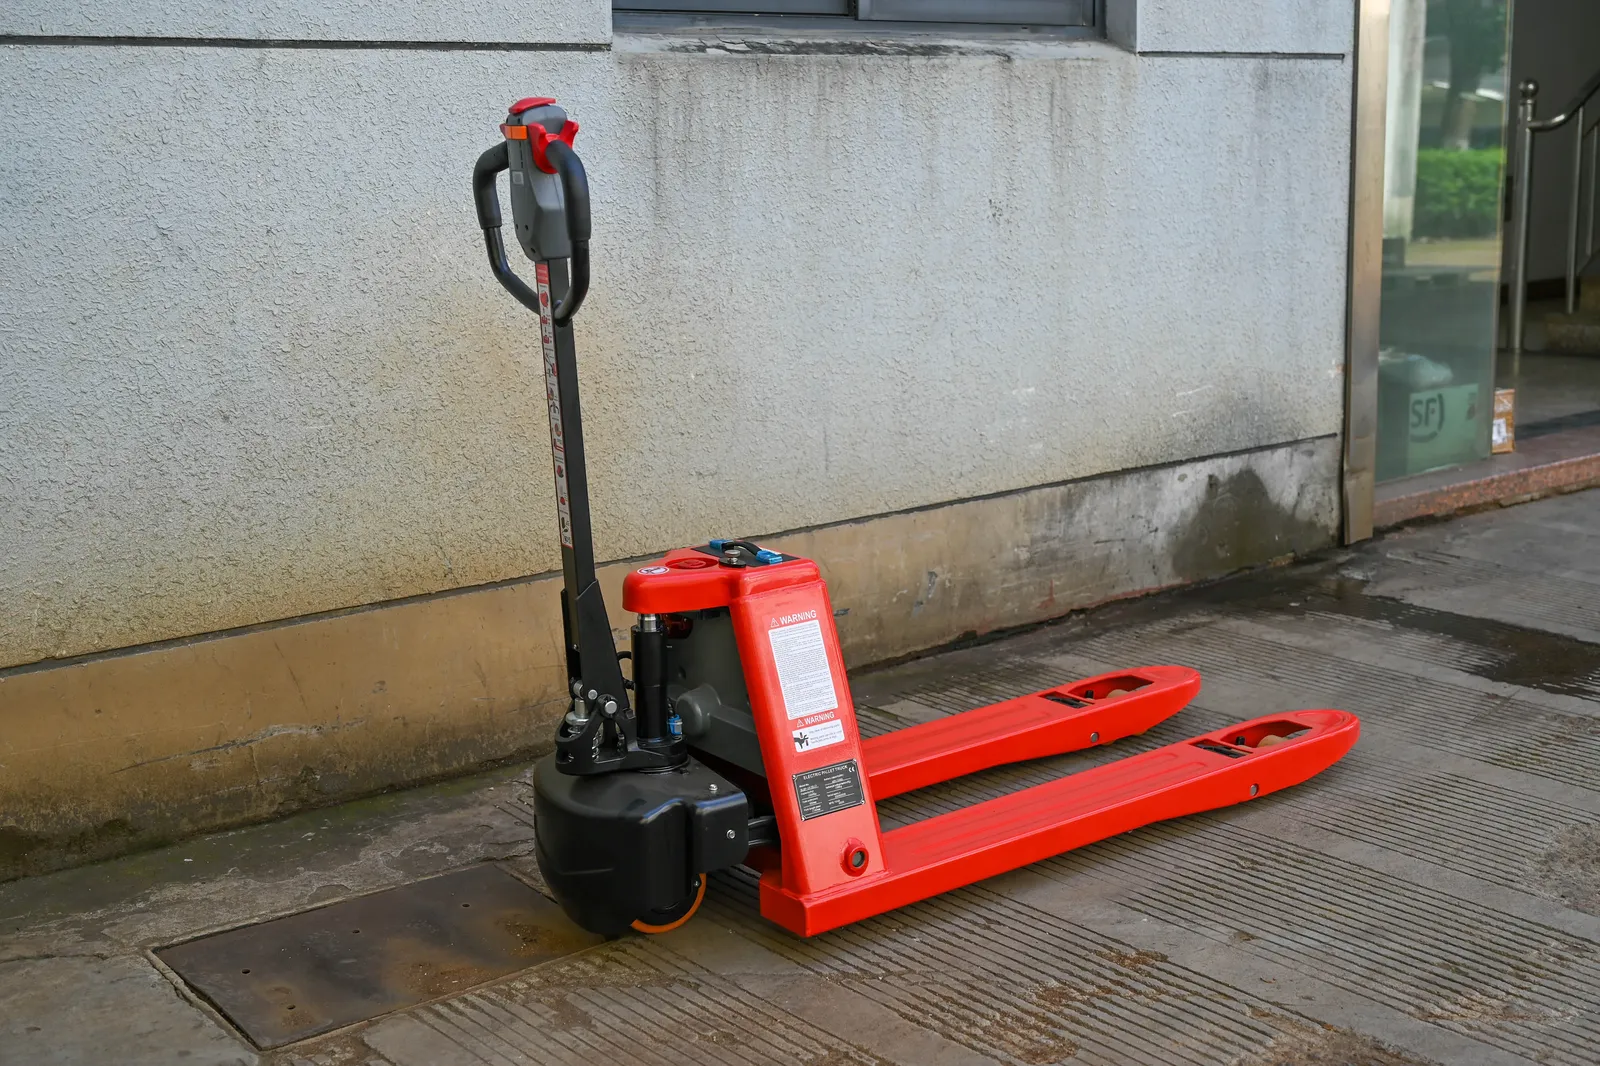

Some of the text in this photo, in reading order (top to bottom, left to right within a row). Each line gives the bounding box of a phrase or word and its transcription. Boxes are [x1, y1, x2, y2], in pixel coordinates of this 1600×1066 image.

[1410, 397, 1437, 429] SF
[780, 610, 817, 625] WARNING
[805, 711, 835, 724] WARNING
[803, 771, 821, 780] ELECTRIC
[821, 767, 835, 775] PALLET
